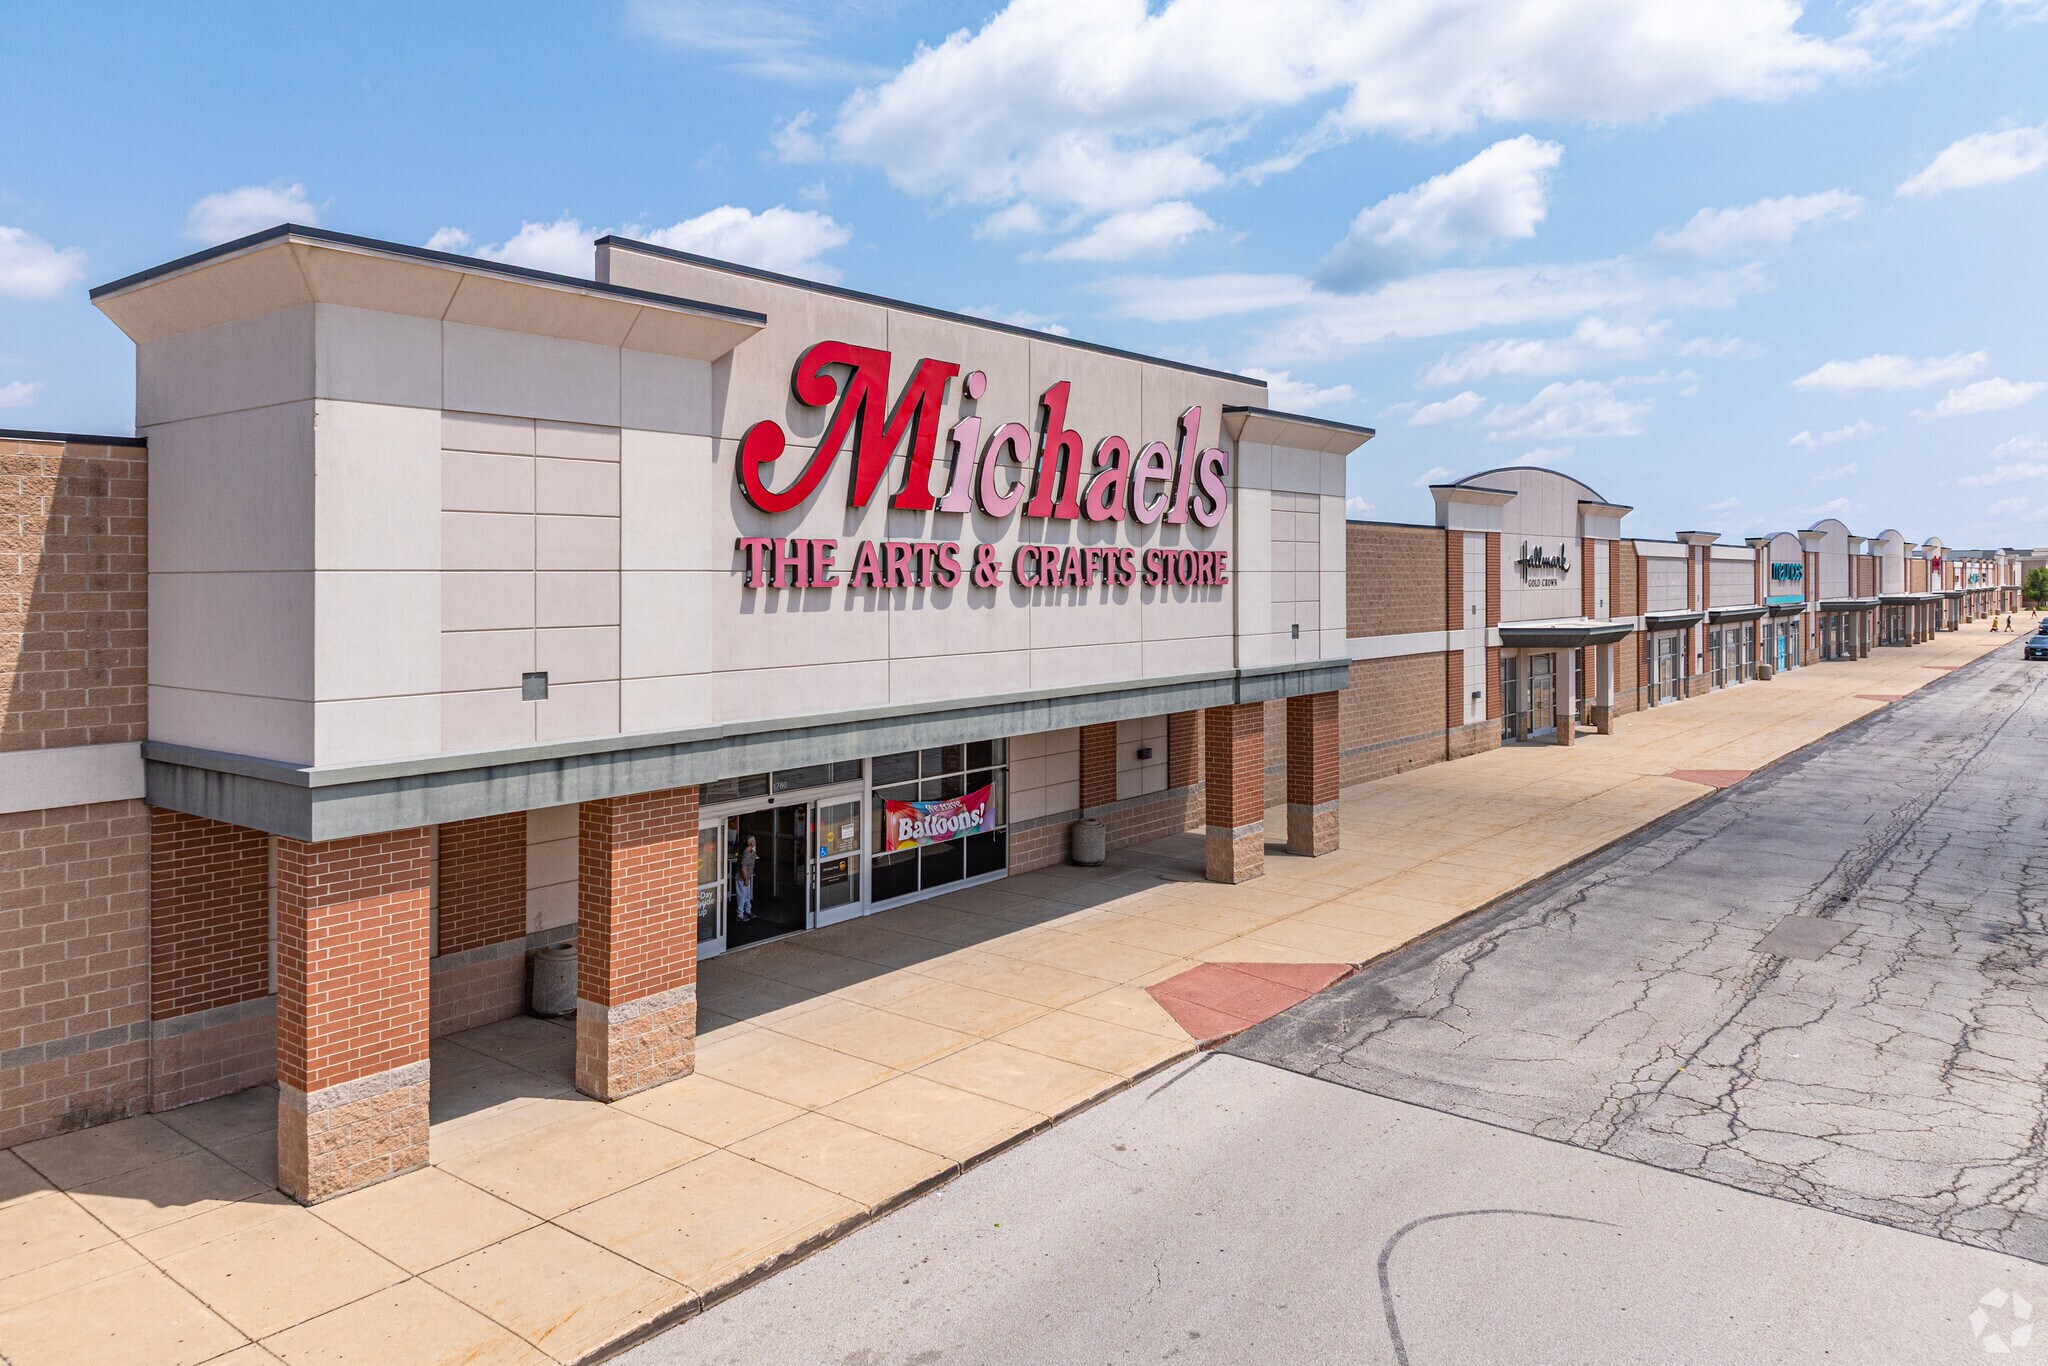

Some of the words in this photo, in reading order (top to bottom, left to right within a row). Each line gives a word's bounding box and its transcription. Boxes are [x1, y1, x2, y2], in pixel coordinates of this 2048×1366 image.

[735, 340, 1229, 528] Michaels
[736, 537, 839, 589] THE
[848, 540, 962, 588] ARTS
[972, 543, 1003, 588] &
[1012, 545, 1136, 588] CRAFTS
[1143, 548, 1229, 587] STORE
[1515, 540, 1571, 583] Hallmark
[1528, 579, 1540, 588] GOLD
[773, 781, 788, 791] 1780
[898, 802, 985, 841] Balloons!
[924, 804, 939, 813] We
[940, 800, 962, 811] Have
